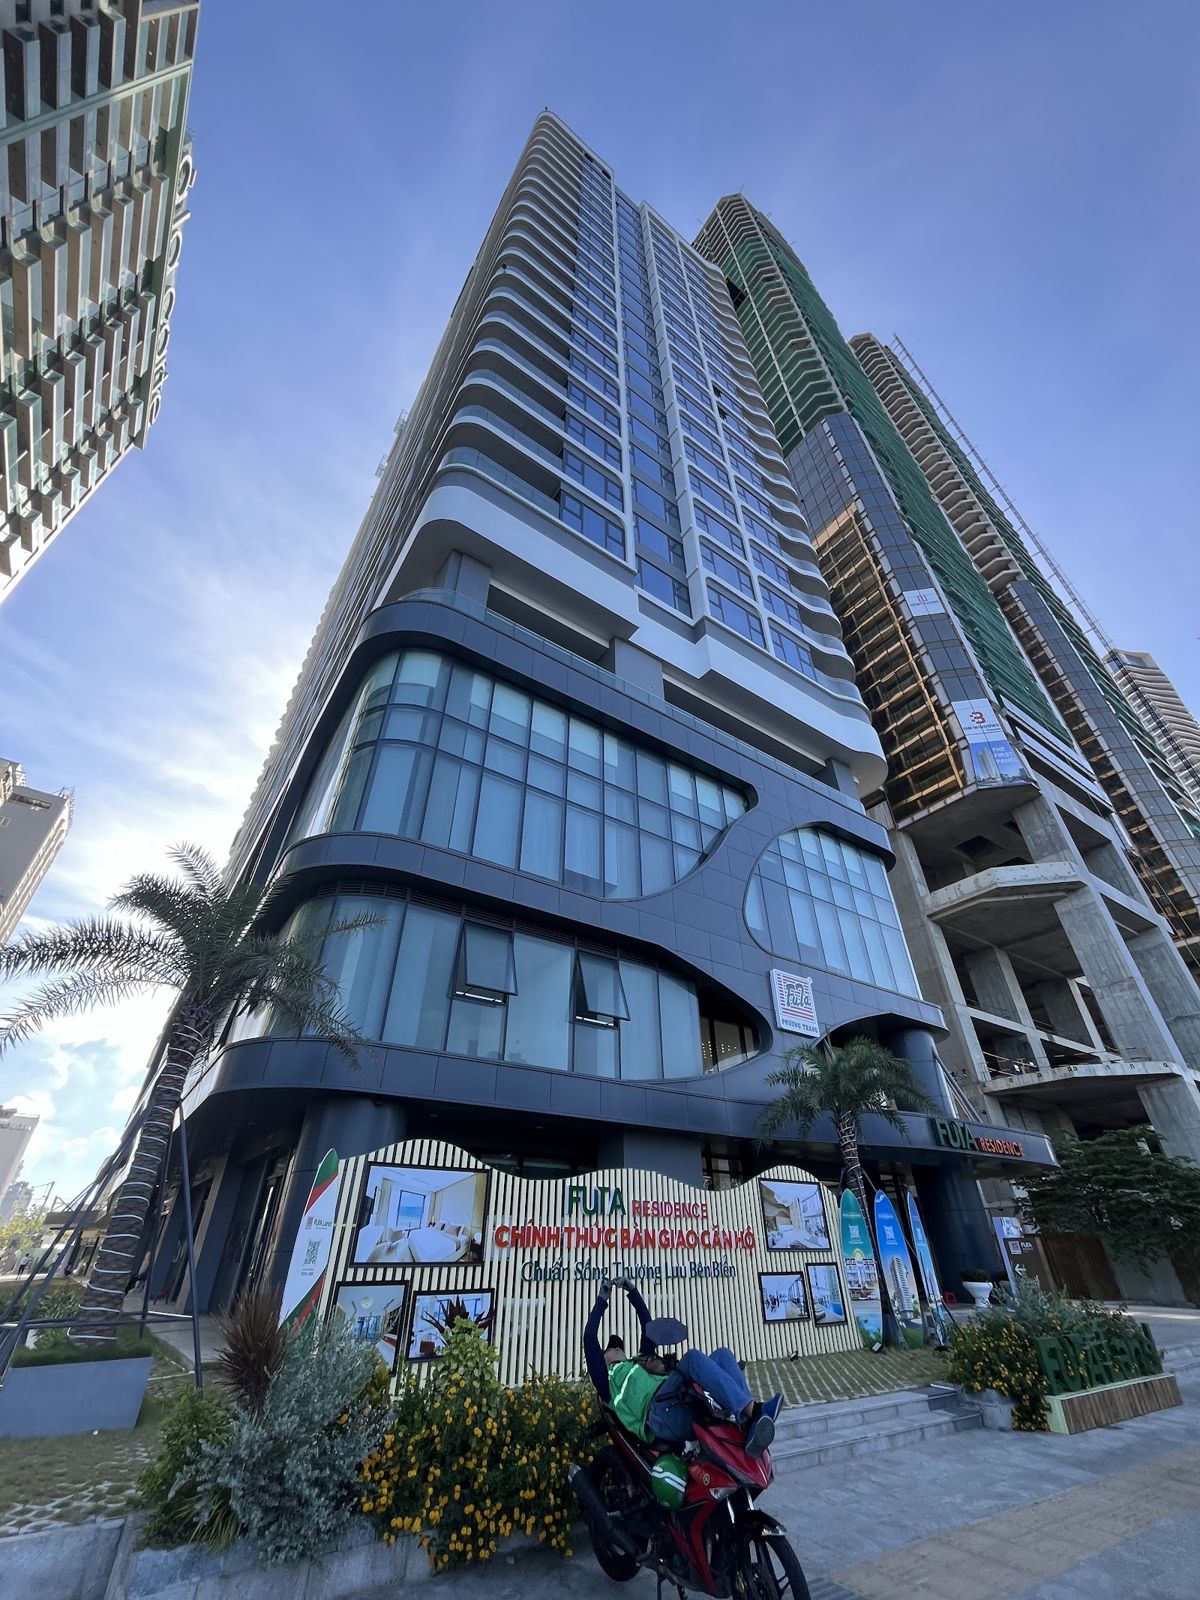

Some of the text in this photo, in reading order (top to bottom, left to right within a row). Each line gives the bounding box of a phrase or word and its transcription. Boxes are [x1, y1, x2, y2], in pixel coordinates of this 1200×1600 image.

[932, 1118, 1025, 1157] FUTA RESIDENCE
[566, 1185, 708, 1219] FUTA RESIDENCE
[494, 1219, 757, 1257] CHÍNH THỨC BÀN GIAO CĂN HỘ
[665, 1261, 686, 1279] Lưu
